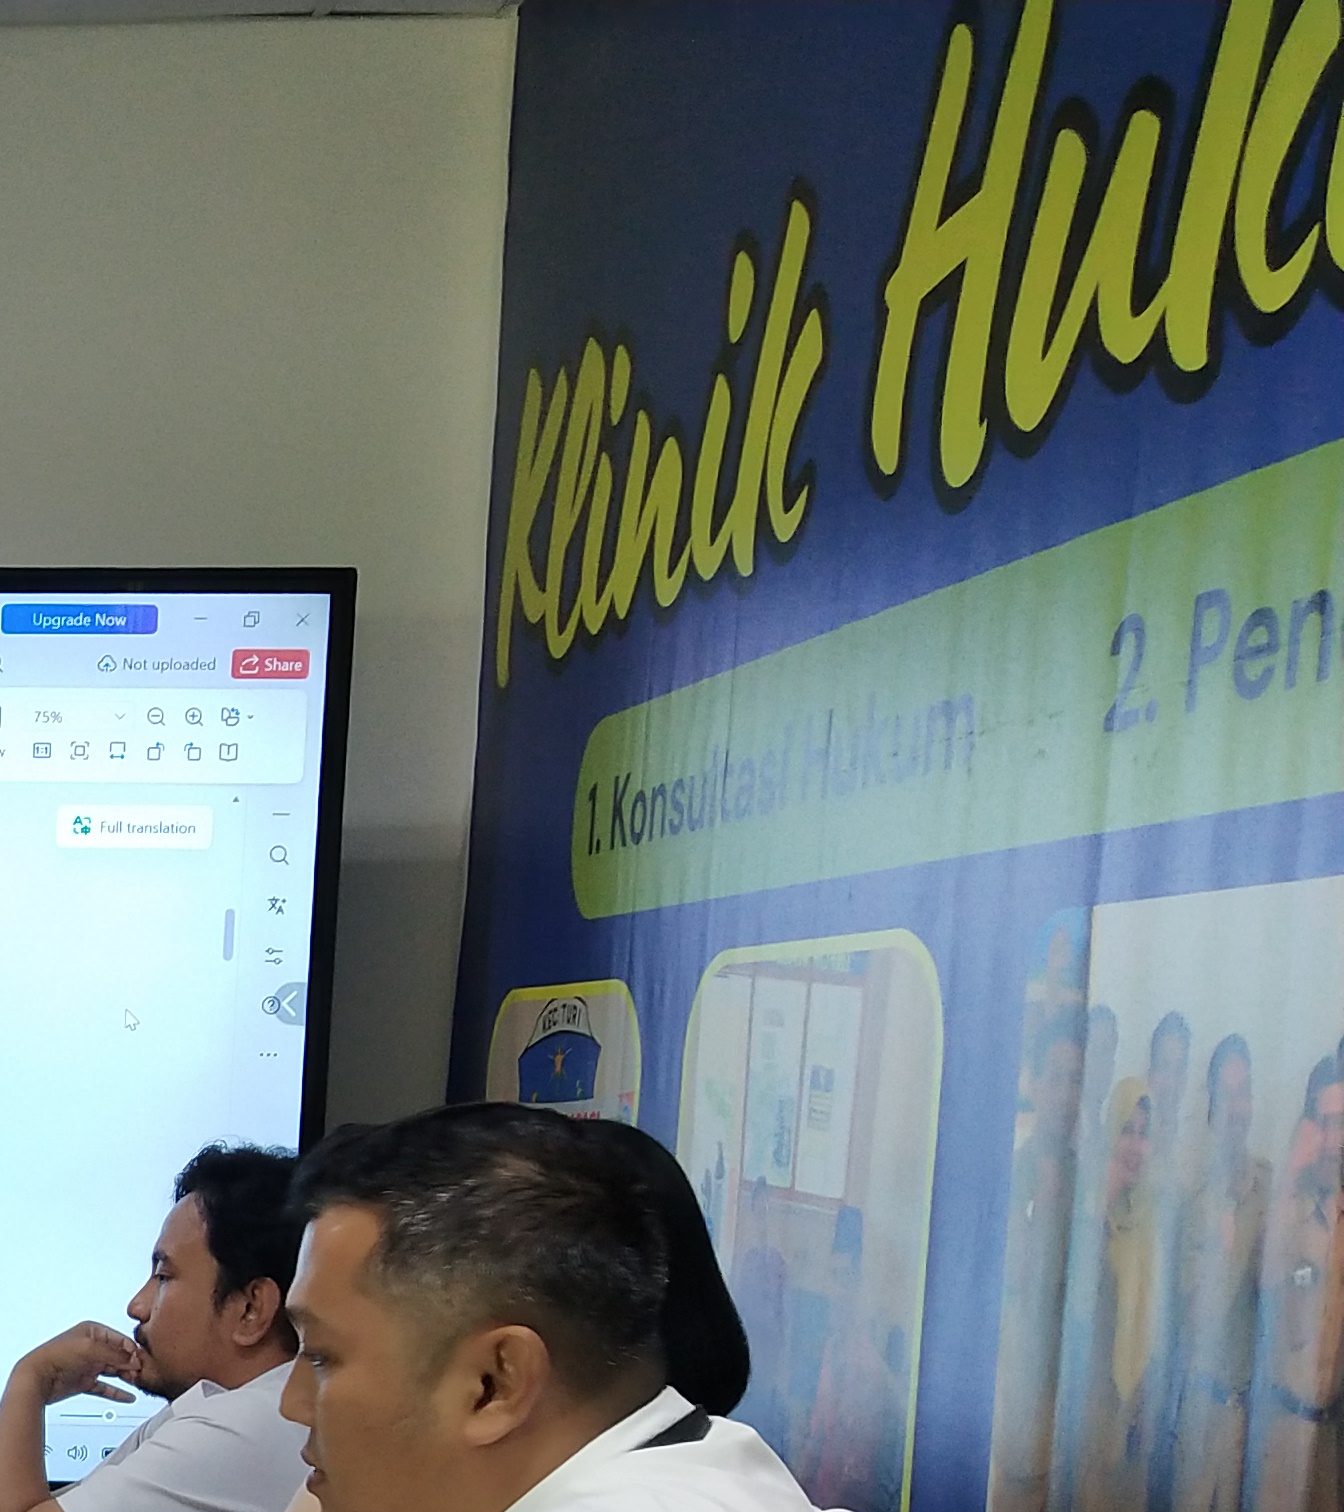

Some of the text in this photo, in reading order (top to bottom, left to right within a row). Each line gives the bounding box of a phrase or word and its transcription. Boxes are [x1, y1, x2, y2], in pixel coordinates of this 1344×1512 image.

[497, 0, 1344, 688] Klinik Huk
[33, 613, 127, 630] Upgrade Now
[123, 656, 216, 673] Not uploaded
[264, 658, 302, 672] Share
[1103, 586, 1344, 734] 2. Pen
[34, 710, 63, 724] 75%
[610, 740, 794, 850] Konsultasi
[803, 692, 979, 795] Hukum
[100, 821, 196, 835] Full translation
